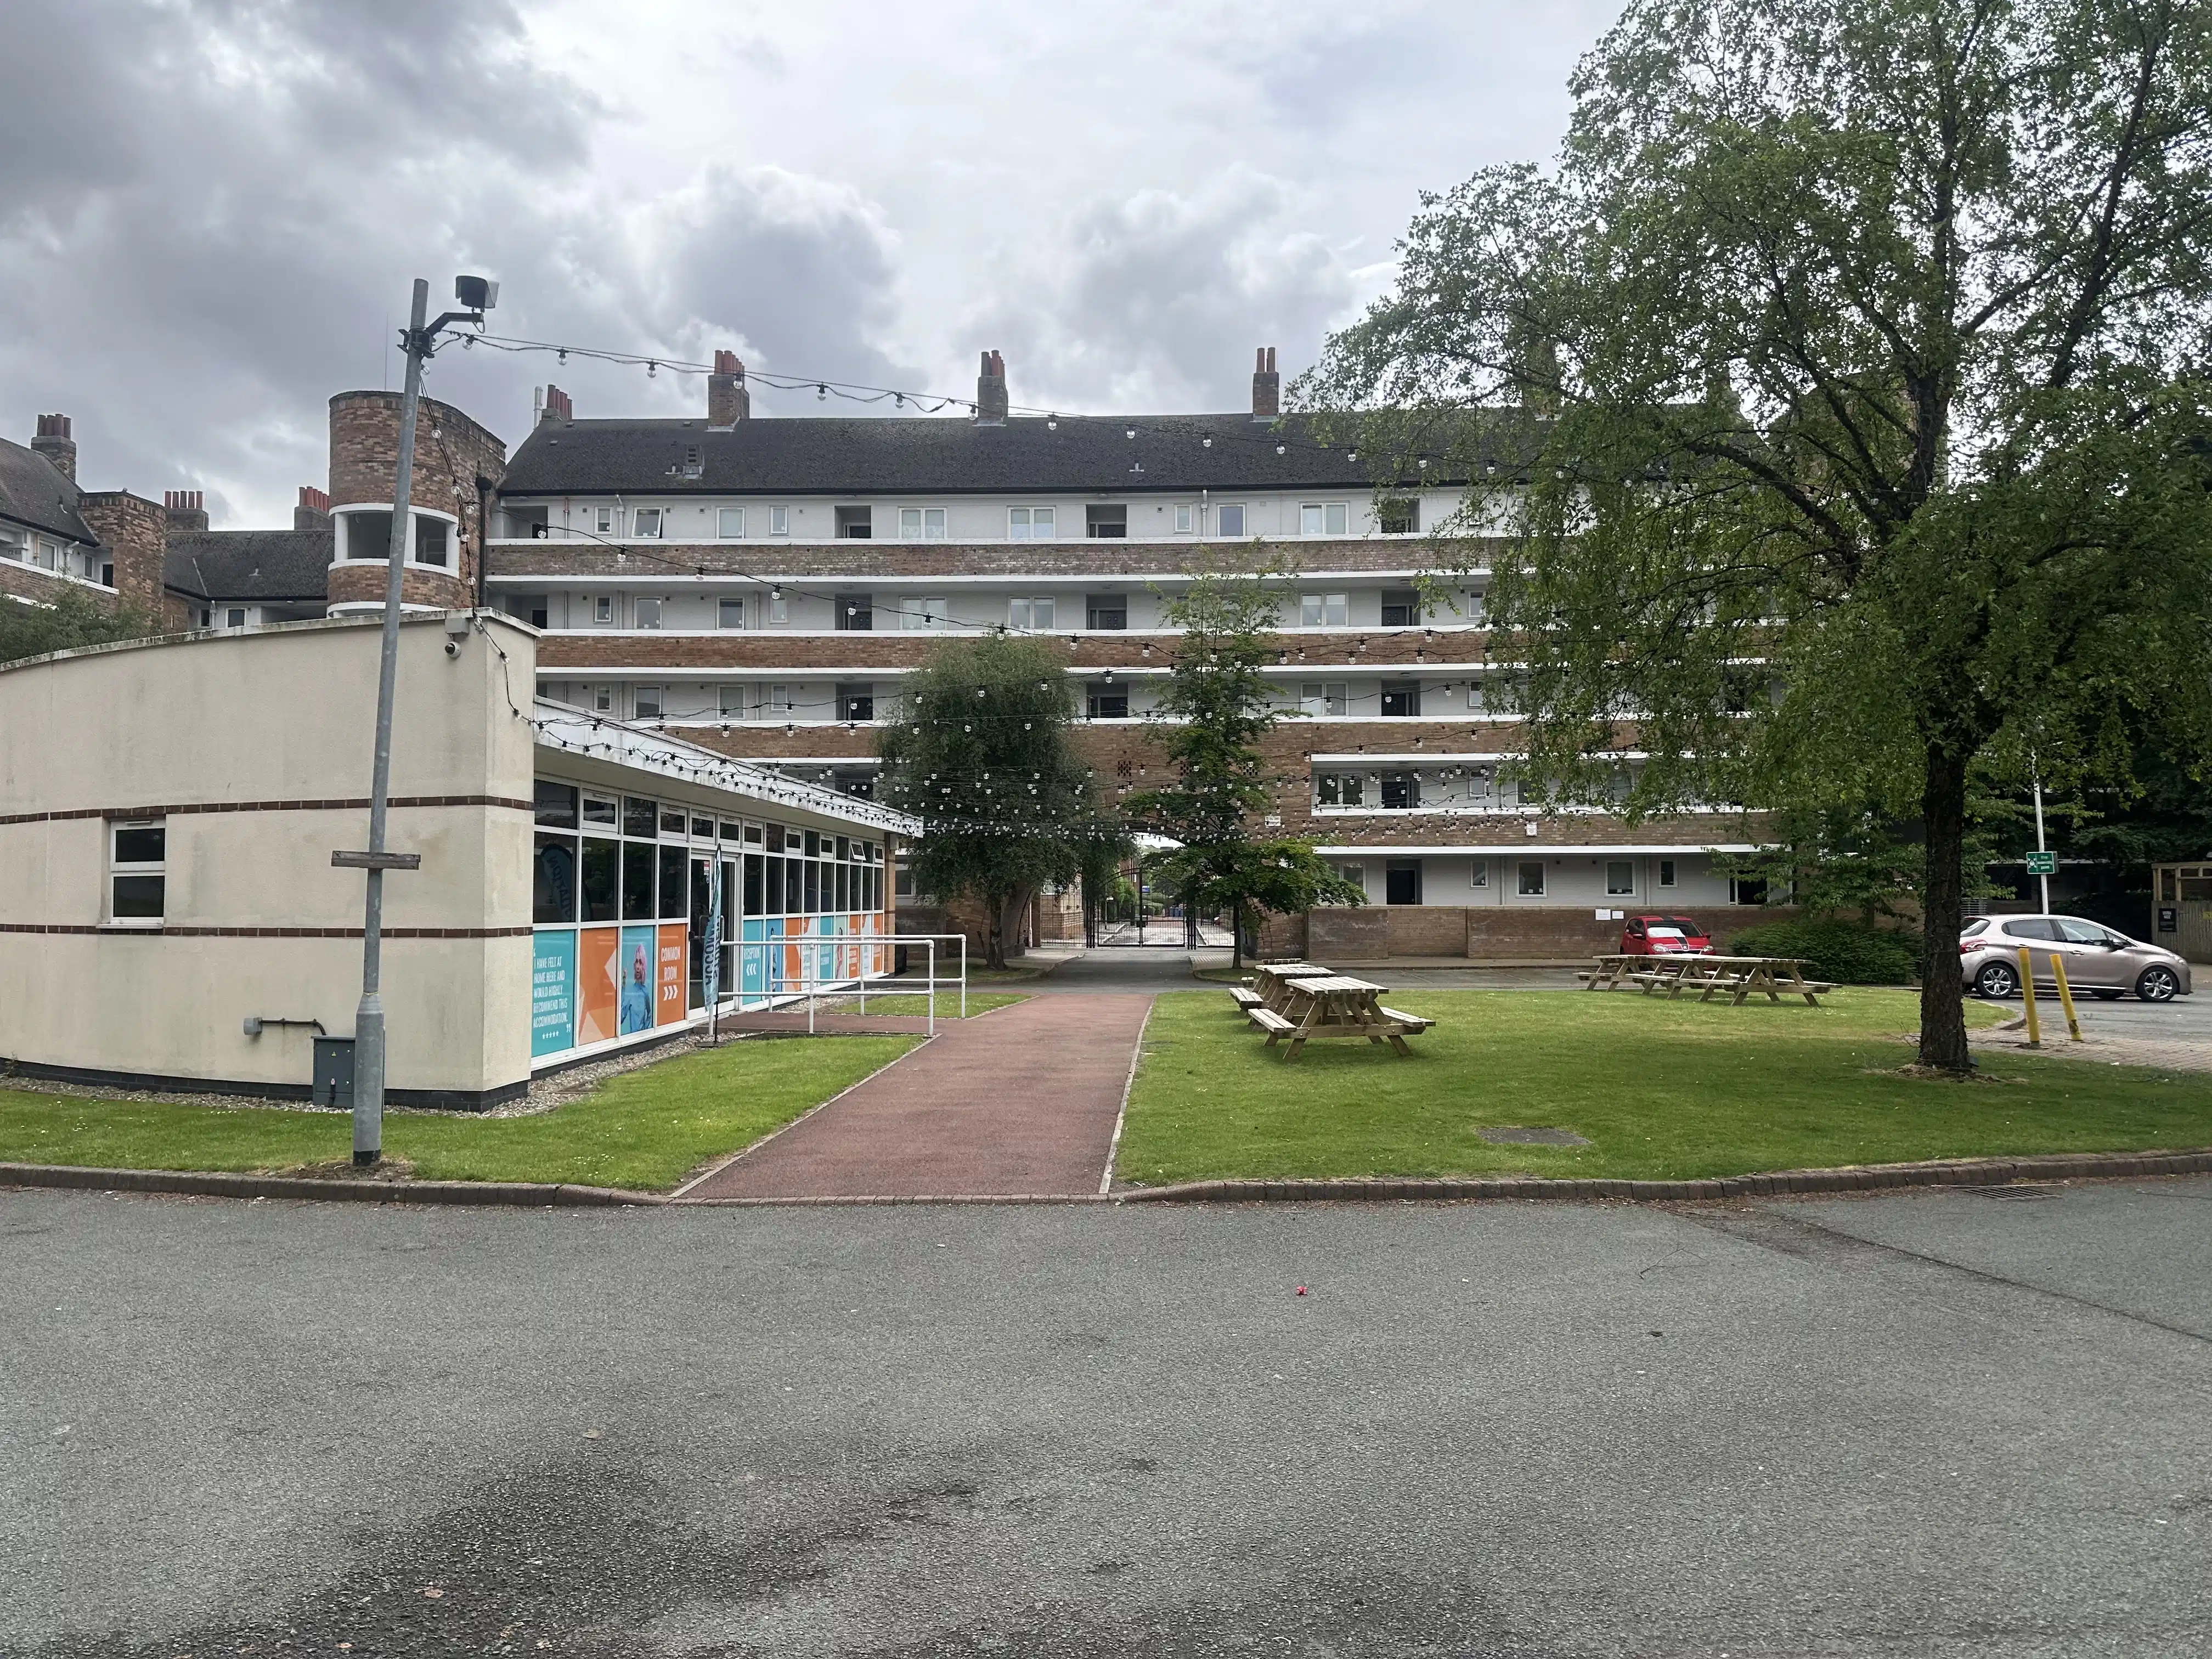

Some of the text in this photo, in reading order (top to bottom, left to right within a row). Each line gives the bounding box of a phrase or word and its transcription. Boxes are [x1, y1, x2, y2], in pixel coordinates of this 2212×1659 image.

[661, 946, 681, 962] COMMON
[537, 957, 547, 969] HAVE
[548, 957, 557, 968] FELT
[557, 956, 562, 967] AT
[534, 970, 565, 984] HOME HERE AND
[664, 966, 678, 981] ROOM
[534, 985, 563, 998] WOULD HIGHLY
[533, 997, 568, 1013] RECOMMEND THIS
